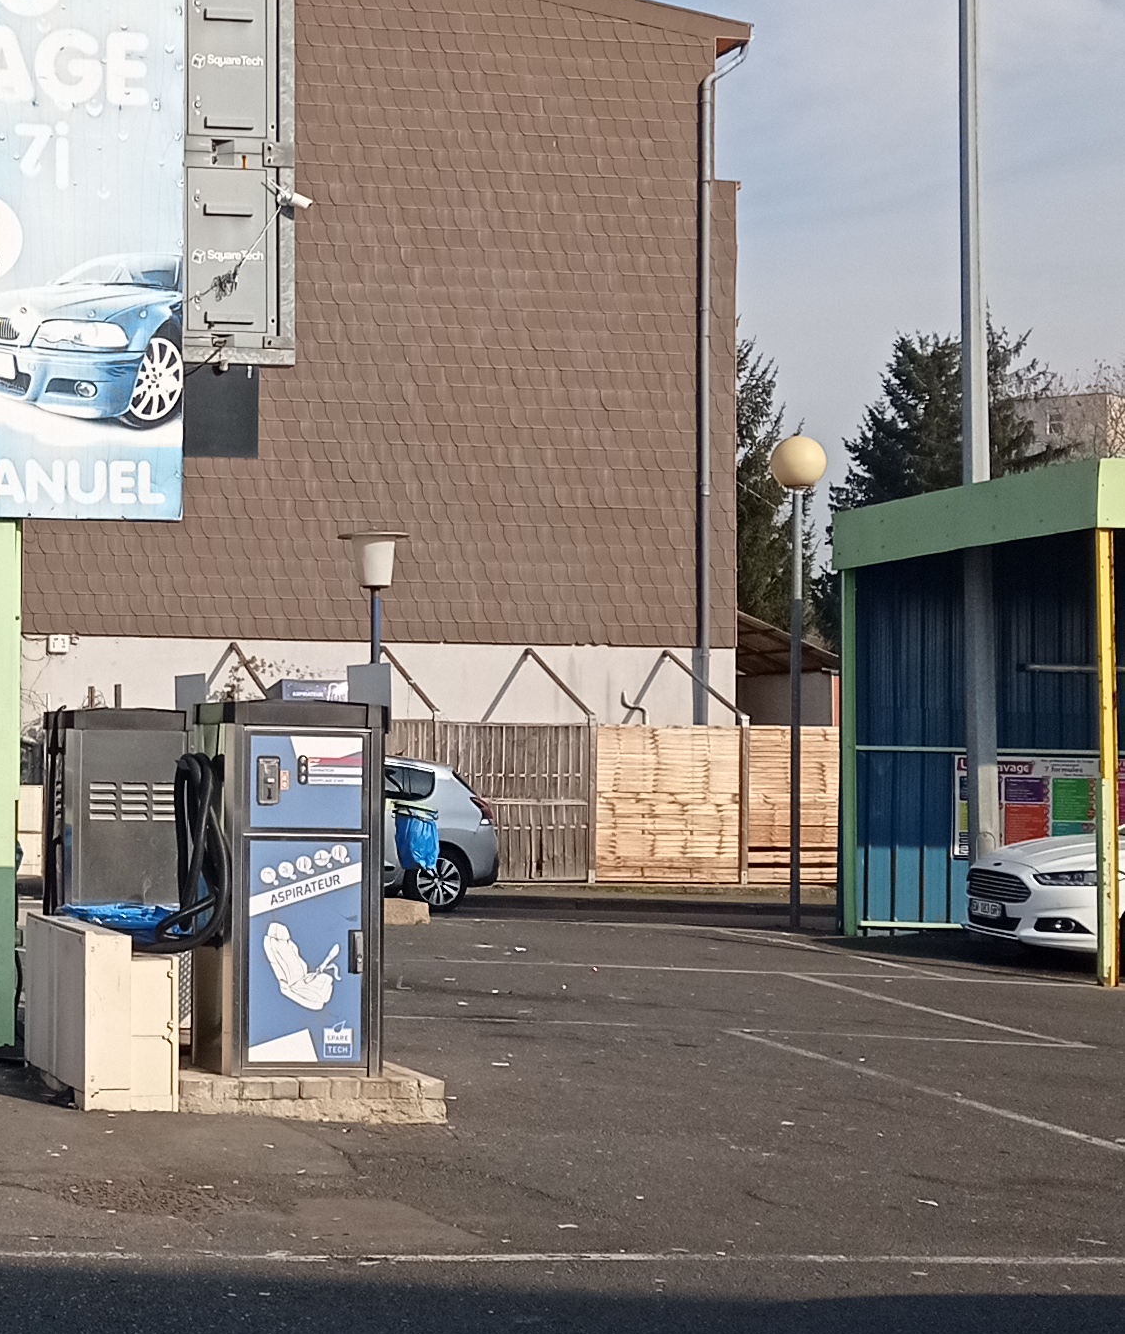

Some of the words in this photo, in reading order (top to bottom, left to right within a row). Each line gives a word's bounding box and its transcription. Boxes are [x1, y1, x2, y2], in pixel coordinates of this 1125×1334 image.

[207, 54, 264, 67] SquareTech
[207, 250, 264, 263] SquareTech
[270, 873, 342, 906] ASPIRATEUR
[326, 1034, 349, 1042] SPARE
[327, 1046, 349, 1055] TECH
